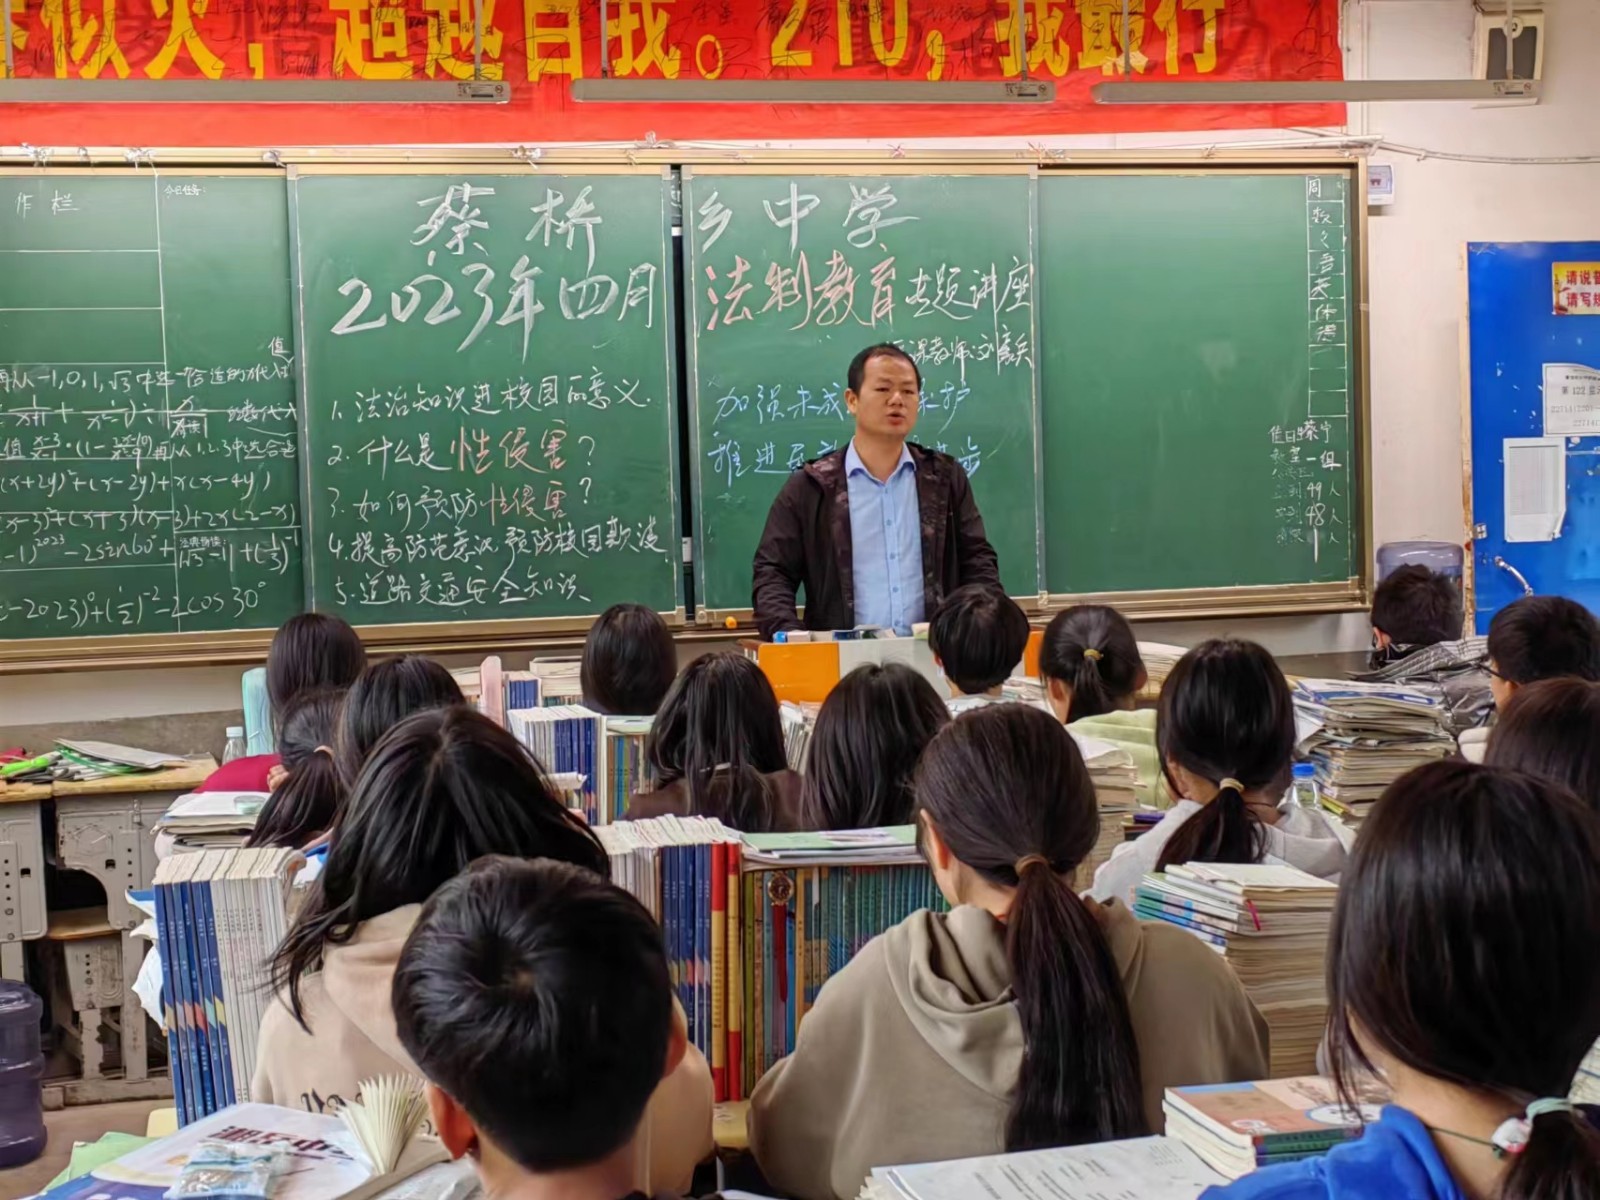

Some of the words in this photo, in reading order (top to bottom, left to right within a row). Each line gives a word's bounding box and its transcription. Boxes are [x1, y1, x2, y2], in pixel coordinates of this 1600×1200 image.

[0, 0, 1225, 82] 似火，超越自我。210，我最行
[330, 254, 657, 365] 2023年四月
